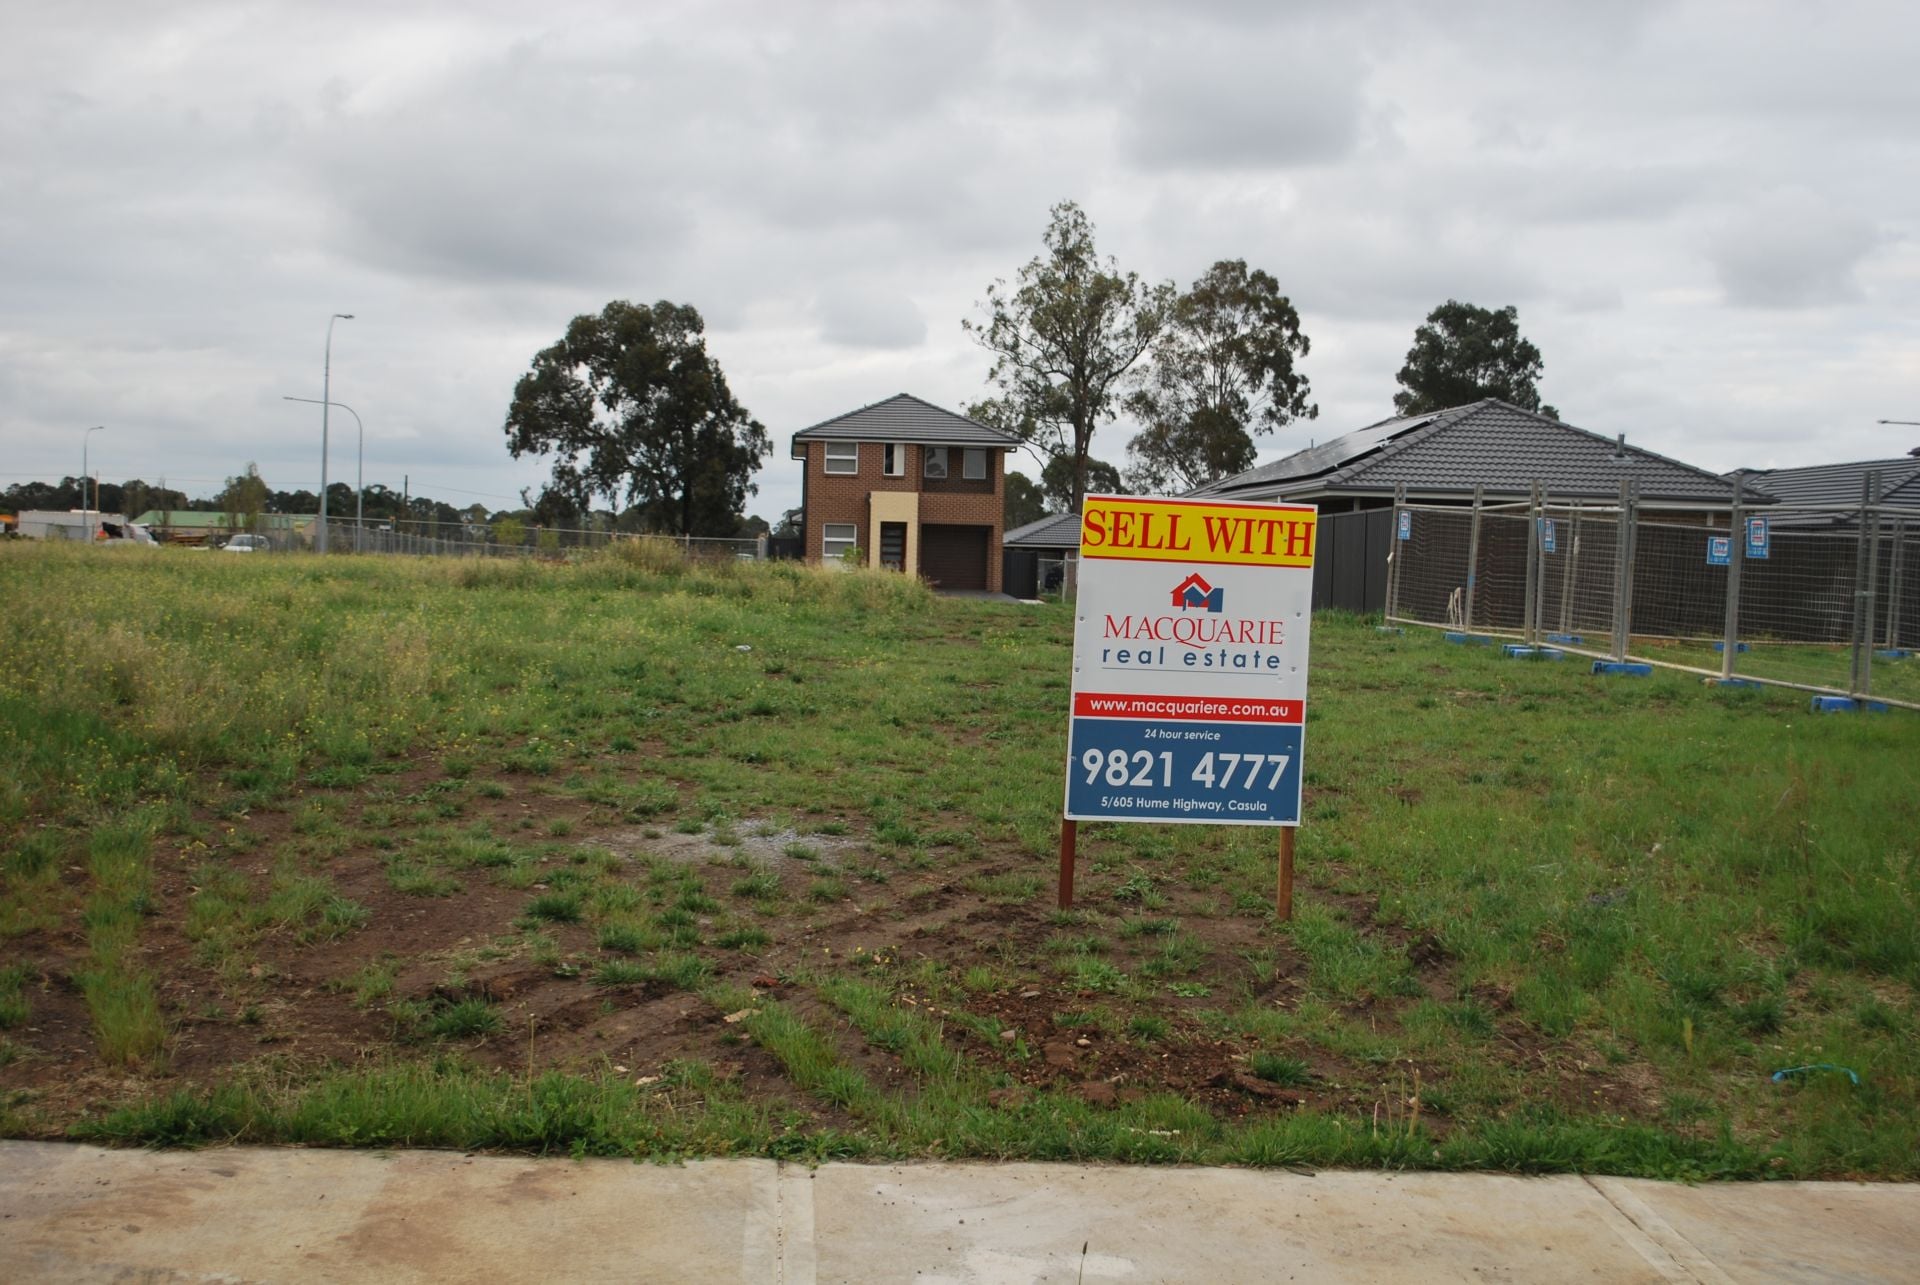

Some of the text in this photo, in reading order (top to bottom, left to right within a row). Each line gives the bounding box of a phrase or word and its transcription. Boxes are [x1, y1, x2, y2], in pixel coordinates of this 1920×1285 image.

[1083, 509, 1315, 557] SELL WITH
[1104, 614, 1284, 649] MACQUARIE
[1102, 646, 1281, 669] real estate
[1090, 699, 1288, 717] www.macquariere.com.au
[1144, 729, 1221, 740] 24 hour service
[1082, 748, 1290, 791] 9821 4777
[1101, 796, 1267, 812] 5/605 Hume Highway, Casula
